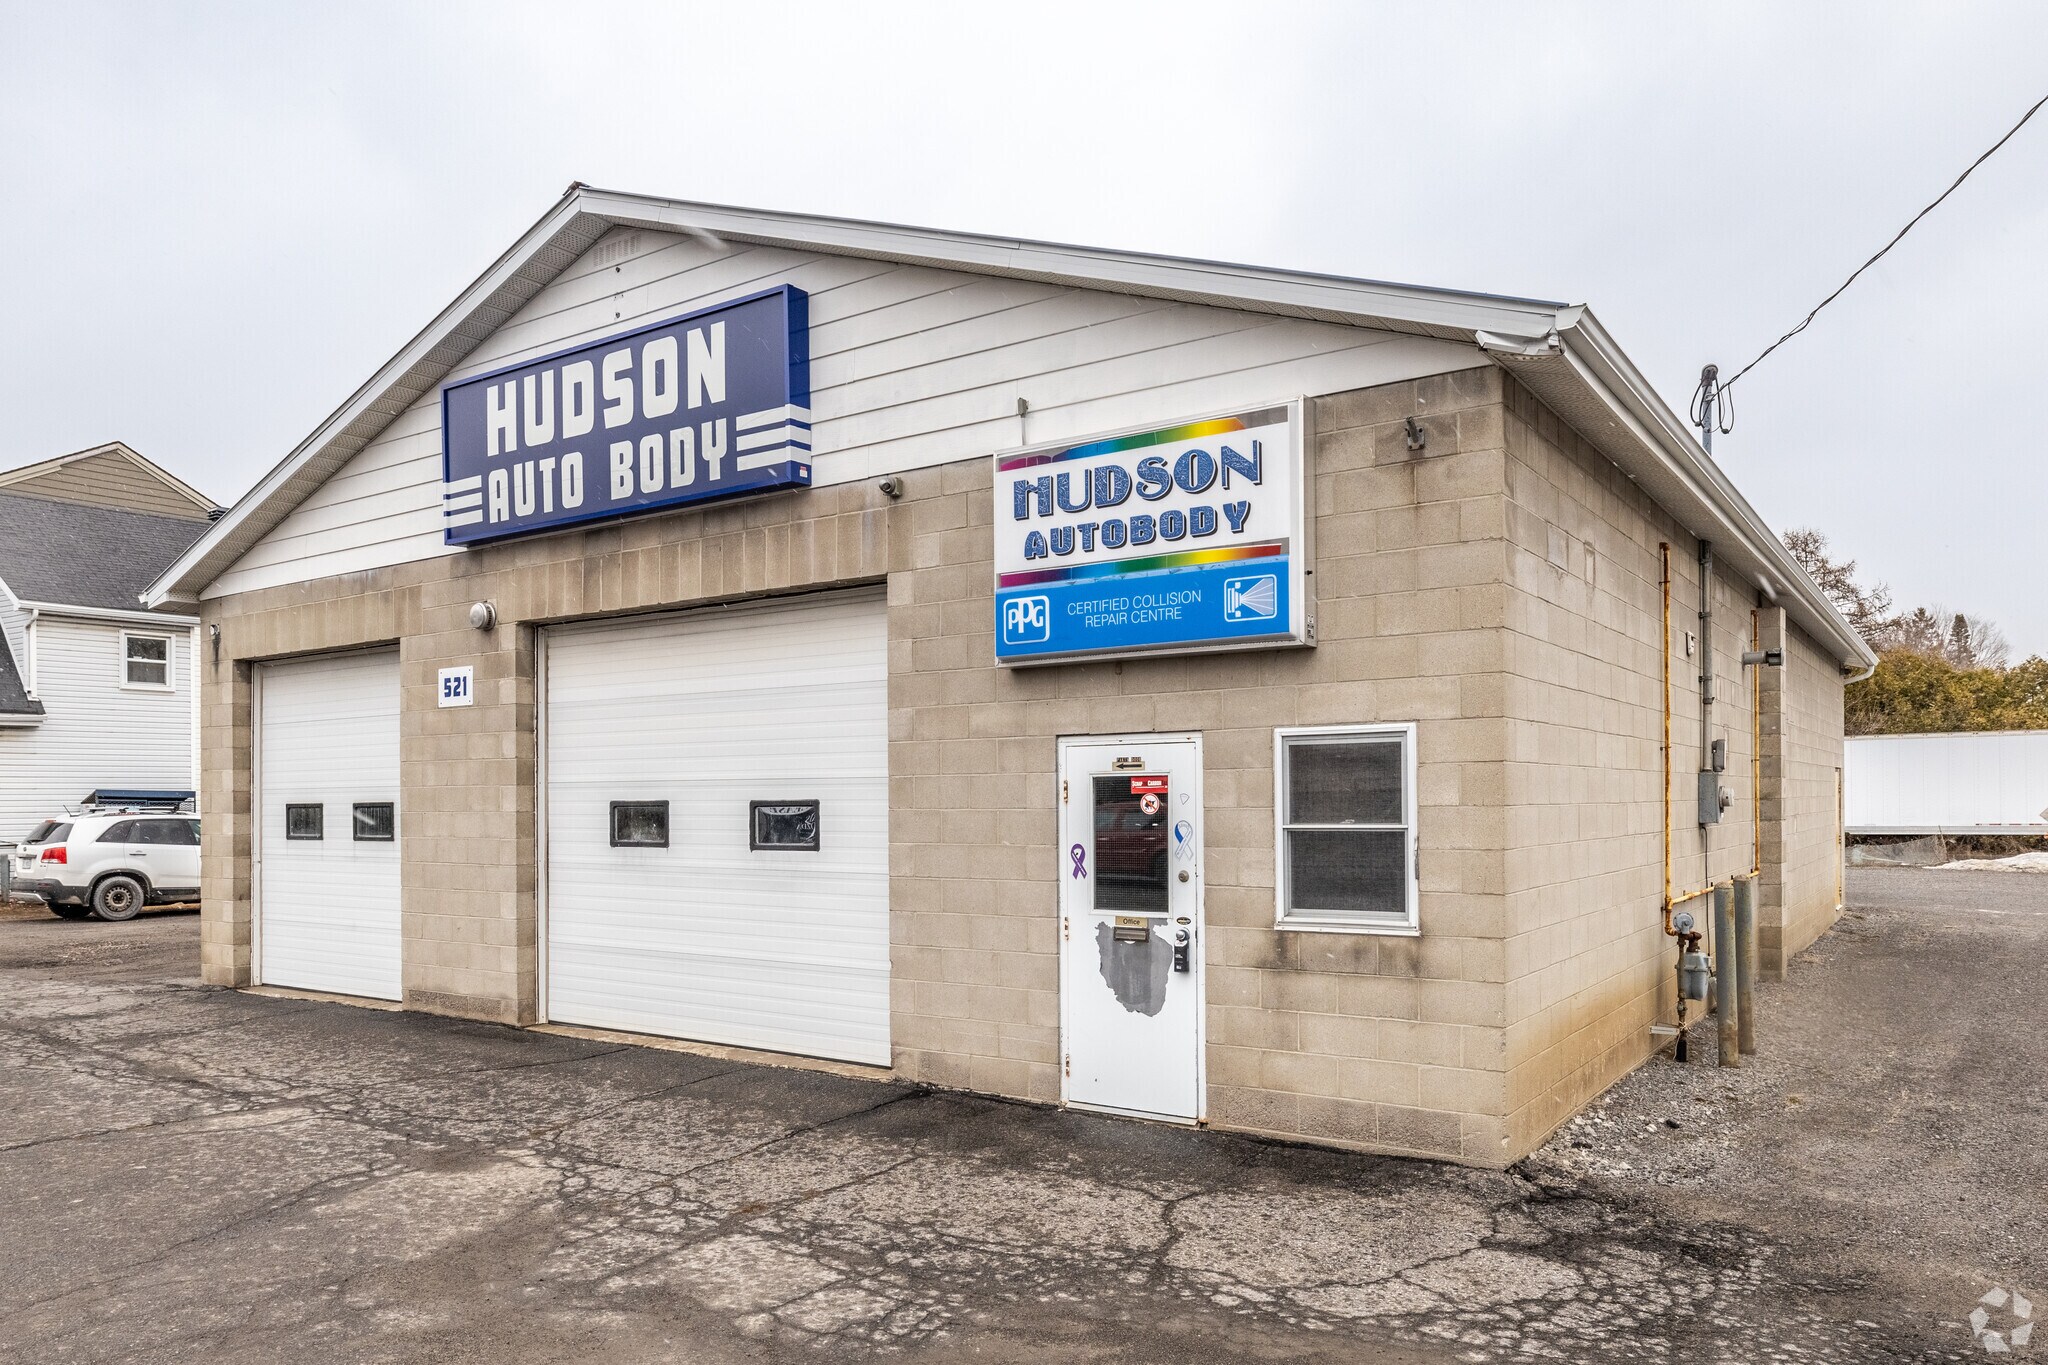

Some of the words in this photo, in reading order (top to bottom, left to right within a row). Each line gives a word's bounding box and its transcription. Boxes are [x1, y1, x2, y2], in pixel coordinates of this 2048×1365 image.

[486, 320, 726, 457] HUDSON
[488, 451, 583, 523] AUTO
[610, 417, 727, 500] BODY
[1013, 440, 1262, 520] HUDSON
[1024, 500, 1251, 560] AUTOBODY
[1008, 599, 1044, 634] PPG
[1067, 598, 1128, 616] CERTIFIED
[1132, 590, 1201, 609] COLLISION
[1085, 613, 1127, 628] REPAIR
[1130, 607, 1182, 624] CENTRE
[444, 676, 467, 697] 521
